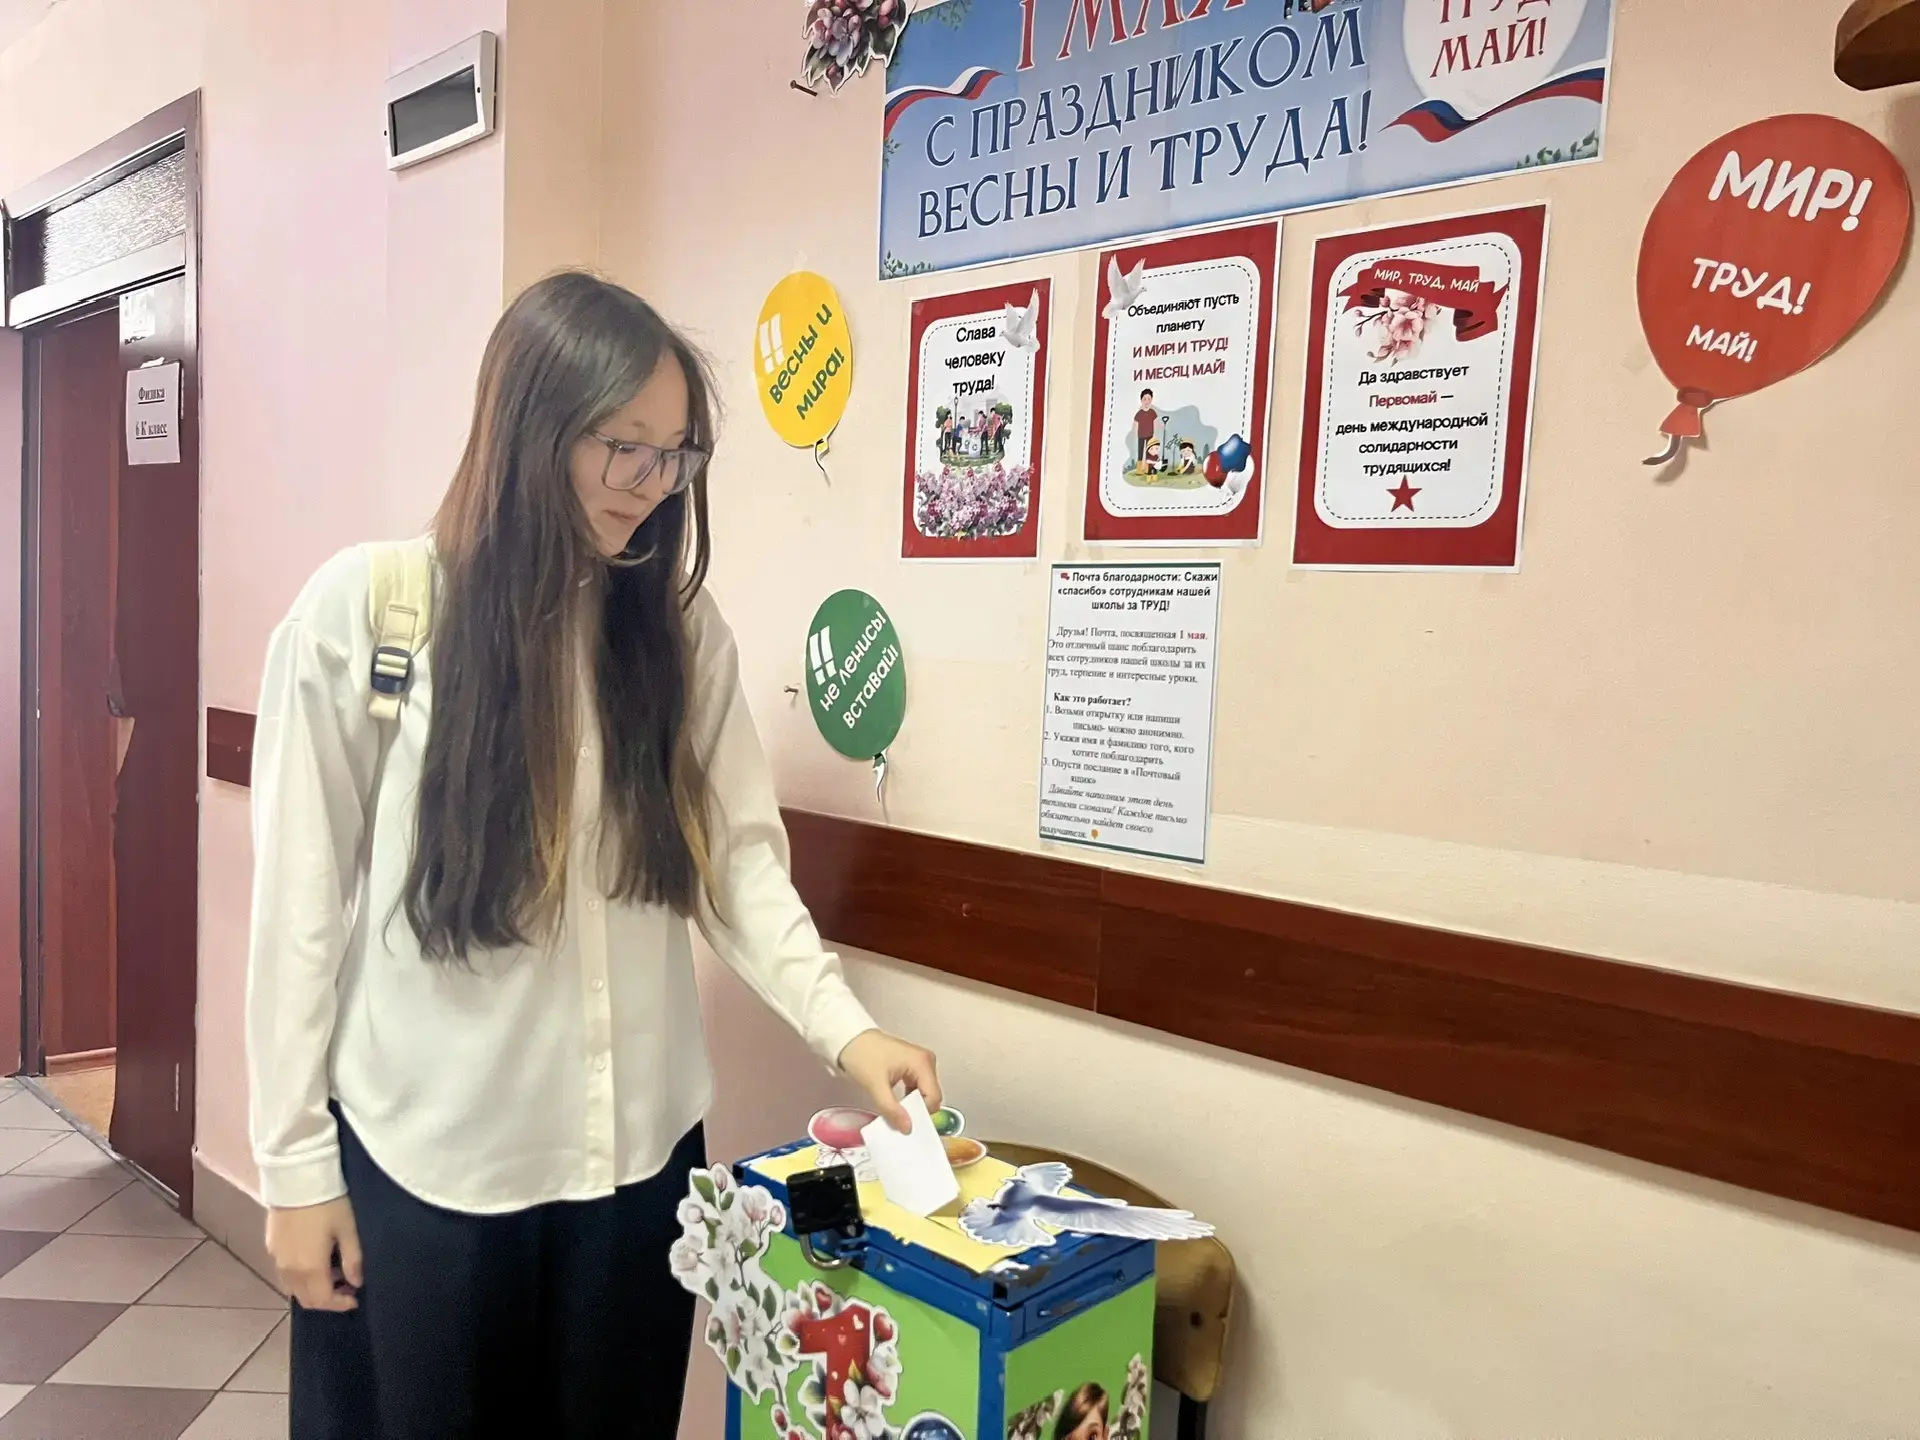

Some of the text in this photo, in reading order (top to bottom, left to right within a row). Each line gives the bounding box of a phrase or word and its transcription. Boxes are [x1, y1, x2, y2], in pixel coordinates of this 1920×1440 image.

[1429, 17, 1547, 78] МАЙ!
[926, 115, 956, 167] С
[969, 8, 1366, 158] ПРАЗДНИКОМ
[918, 90, 1371, 238] ВЕСНЫ И ТРУДА!
[1708, 150, 1873, 231] МИР!
[1374, 268, 1479, 293] МИР, ТРУД, МАЙ
[1691, 257, 1811, 315] ТРУД!
[1127, 293, 1239, 317] Объединяют пусть
[956, 327, 996, 342] Слава
[1156, 319, 1205, 334] планету
[1133, 337, 1229, 358] И МИР! И ТРУД!
[1686, 324, 1758, 363] МАЙ!
[945, 350, 1006, 369] человеку
[1133, 358, 1226, 381] И МЕСЯЦ МАЙ!
[1358, 364, 1469, 386] Да здравствует
[952, 374, 995, 396] труда!
[1369, 390, 1437, 408] Первомай
[1336, 412, 1488, 435] день международной
[1358, 439, 1458, 454] солидарности
[1363, 458, 1451, 476] трудящихся!
[1072, 571, 1218, 583] Почта благодарности: Скажи
[1057, 586, 1211, 598] «спасибо» сотрудникам нашей
[1091, 600, 1170, 611] школы за ТРУД!
[1056, 626, 1088, 637] Друзья!
[1131, 643, 1197, 655] поблагодарить
[1066, 655, 1119, 665] сотрудников
[1053, 692, 1070, 702] Как
[1087, 695, 1132, 706] работает?
[1054, 705, 1084, 716] Возьми
[1085, 709, 1125, 722] открытку
